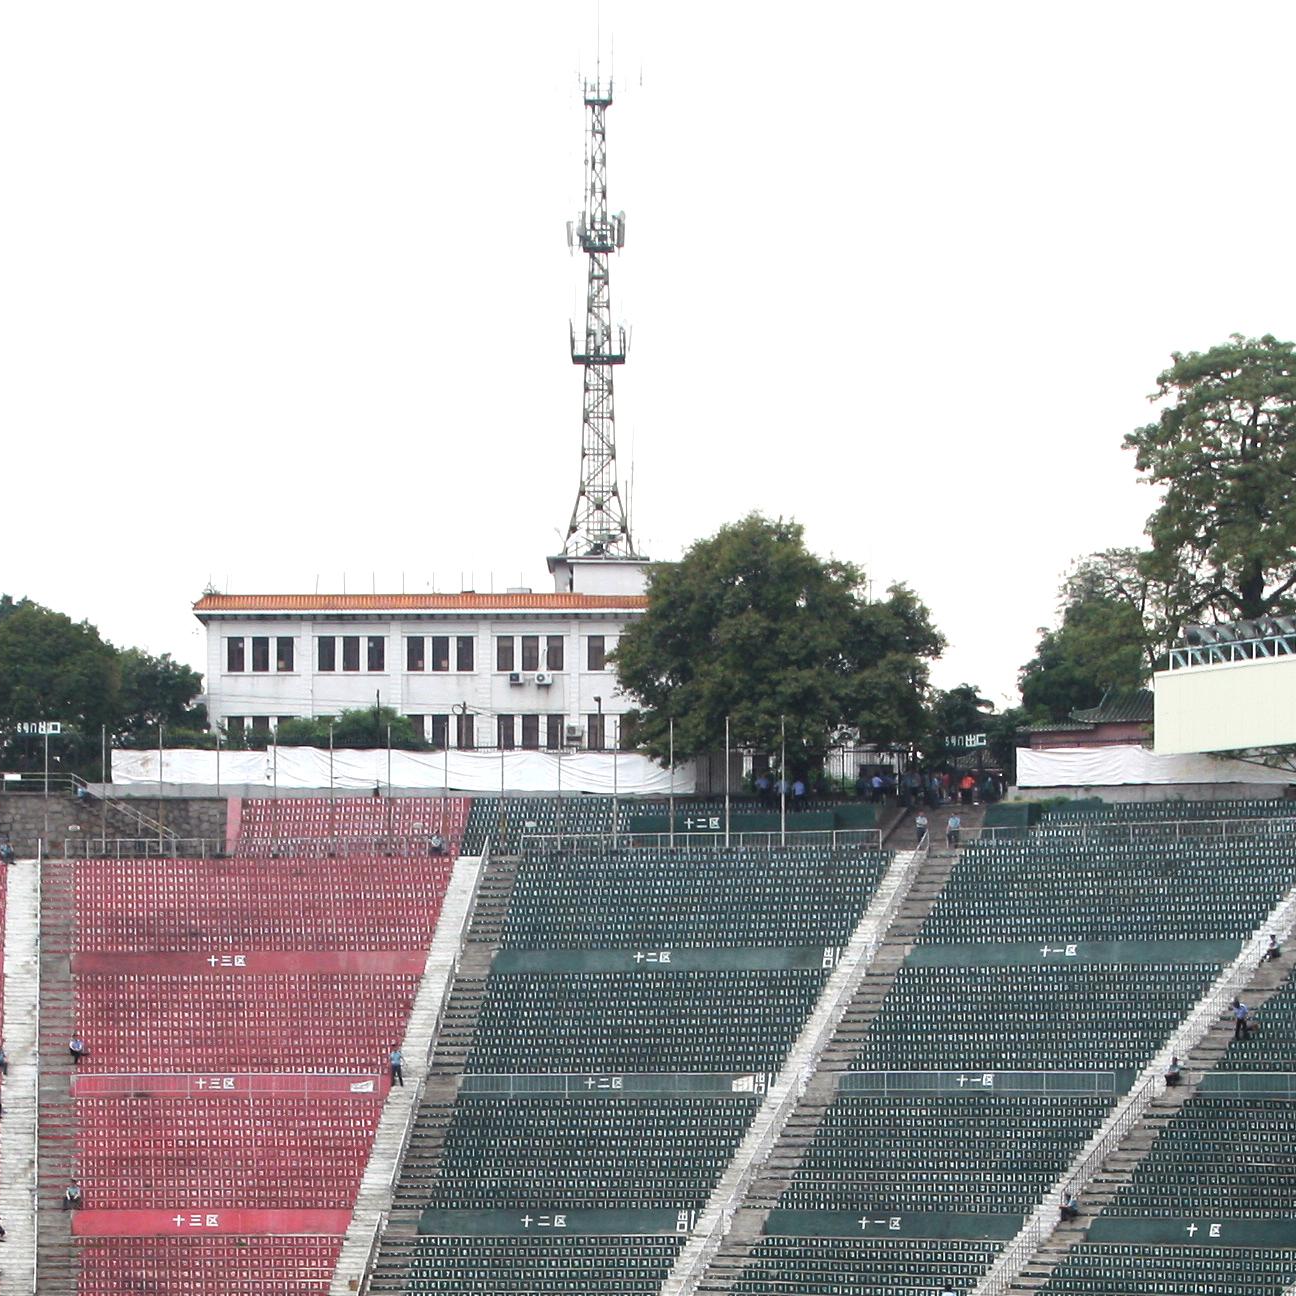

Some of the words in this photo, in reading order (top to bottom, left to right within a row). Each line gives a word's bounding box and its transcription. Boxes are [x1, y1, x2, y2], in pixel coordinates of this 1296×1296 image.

[684, 818, 720, 830] 十二区
[633, 951, 672, 964] 十二区
[1040, 944, 1078, 958] 十一区
[207, 954, 247, 967] 十三区
[196, 1077, 236, 1090] 十三区
[584, 1077, 623, 1090] 十二区
[956, 1074, 993, 1087] 十一区
[172, 1214, 219, 1228] 十三区
[520, 1213, 567, 1228] 十二区
[858, 1216, 902, 1231] 十一区
[1186, 1223, 1222, 1238] 十区
